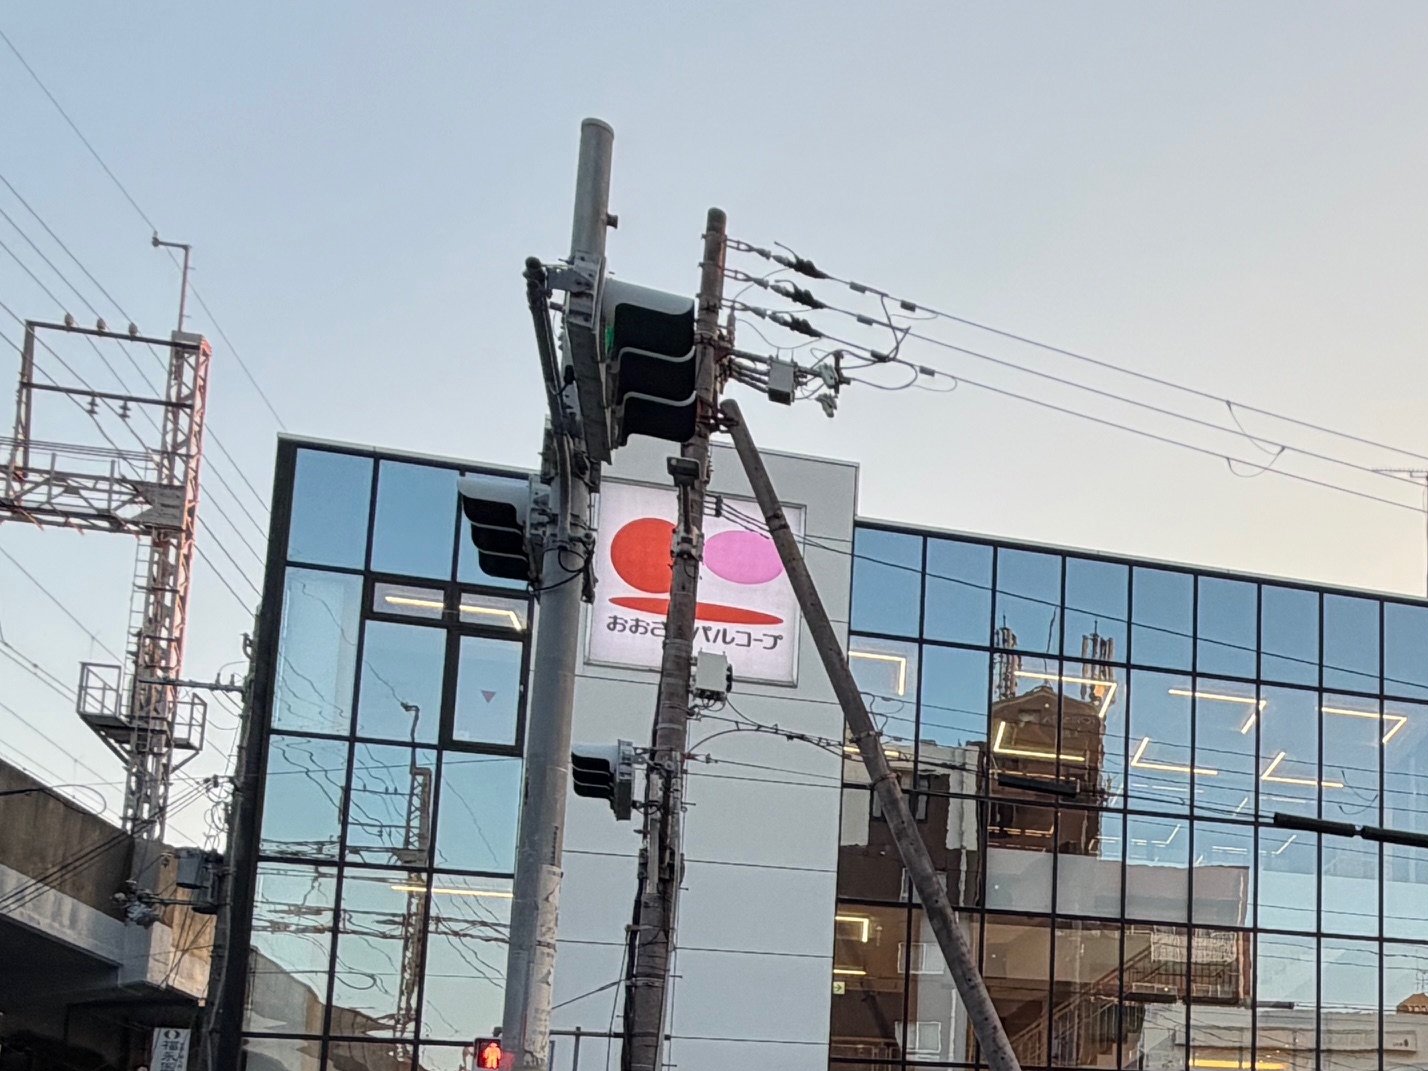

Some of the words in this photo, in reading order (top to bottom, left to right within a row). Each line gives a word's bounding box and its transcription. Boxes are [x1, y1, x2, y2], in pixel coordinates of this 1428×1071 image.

[606, 614, 783, 650] おおさパルコープ
